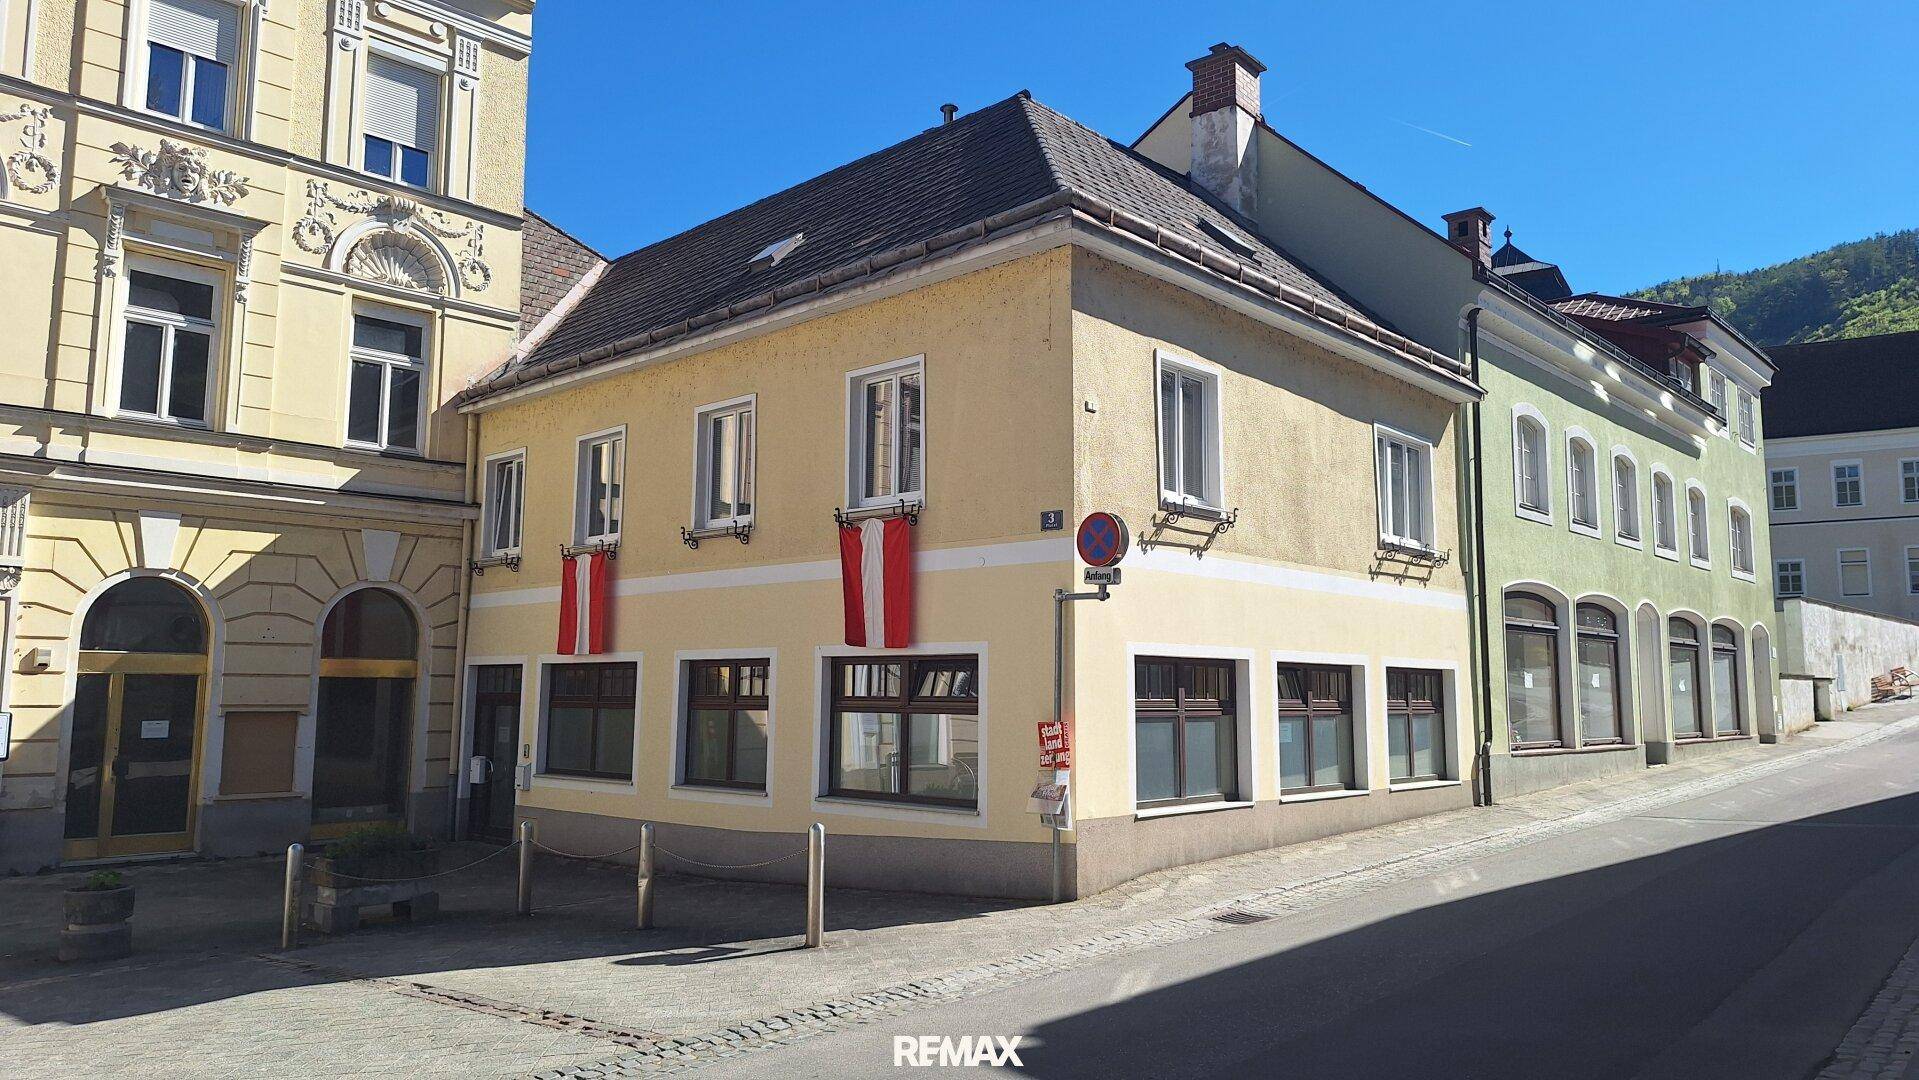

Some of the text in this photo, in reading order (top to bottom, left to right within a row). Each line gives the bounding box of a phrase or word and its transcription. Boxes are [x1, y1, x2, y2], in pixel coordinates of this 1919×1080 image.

[1048, 512, 1055, 523] 3
[1085, 570, 1112, 582] Anfang
[1041, 721, 1062, 738] stadt
[1044, 734, 1063, 751] land
[1040, 750, 1070, 766] zeiung
